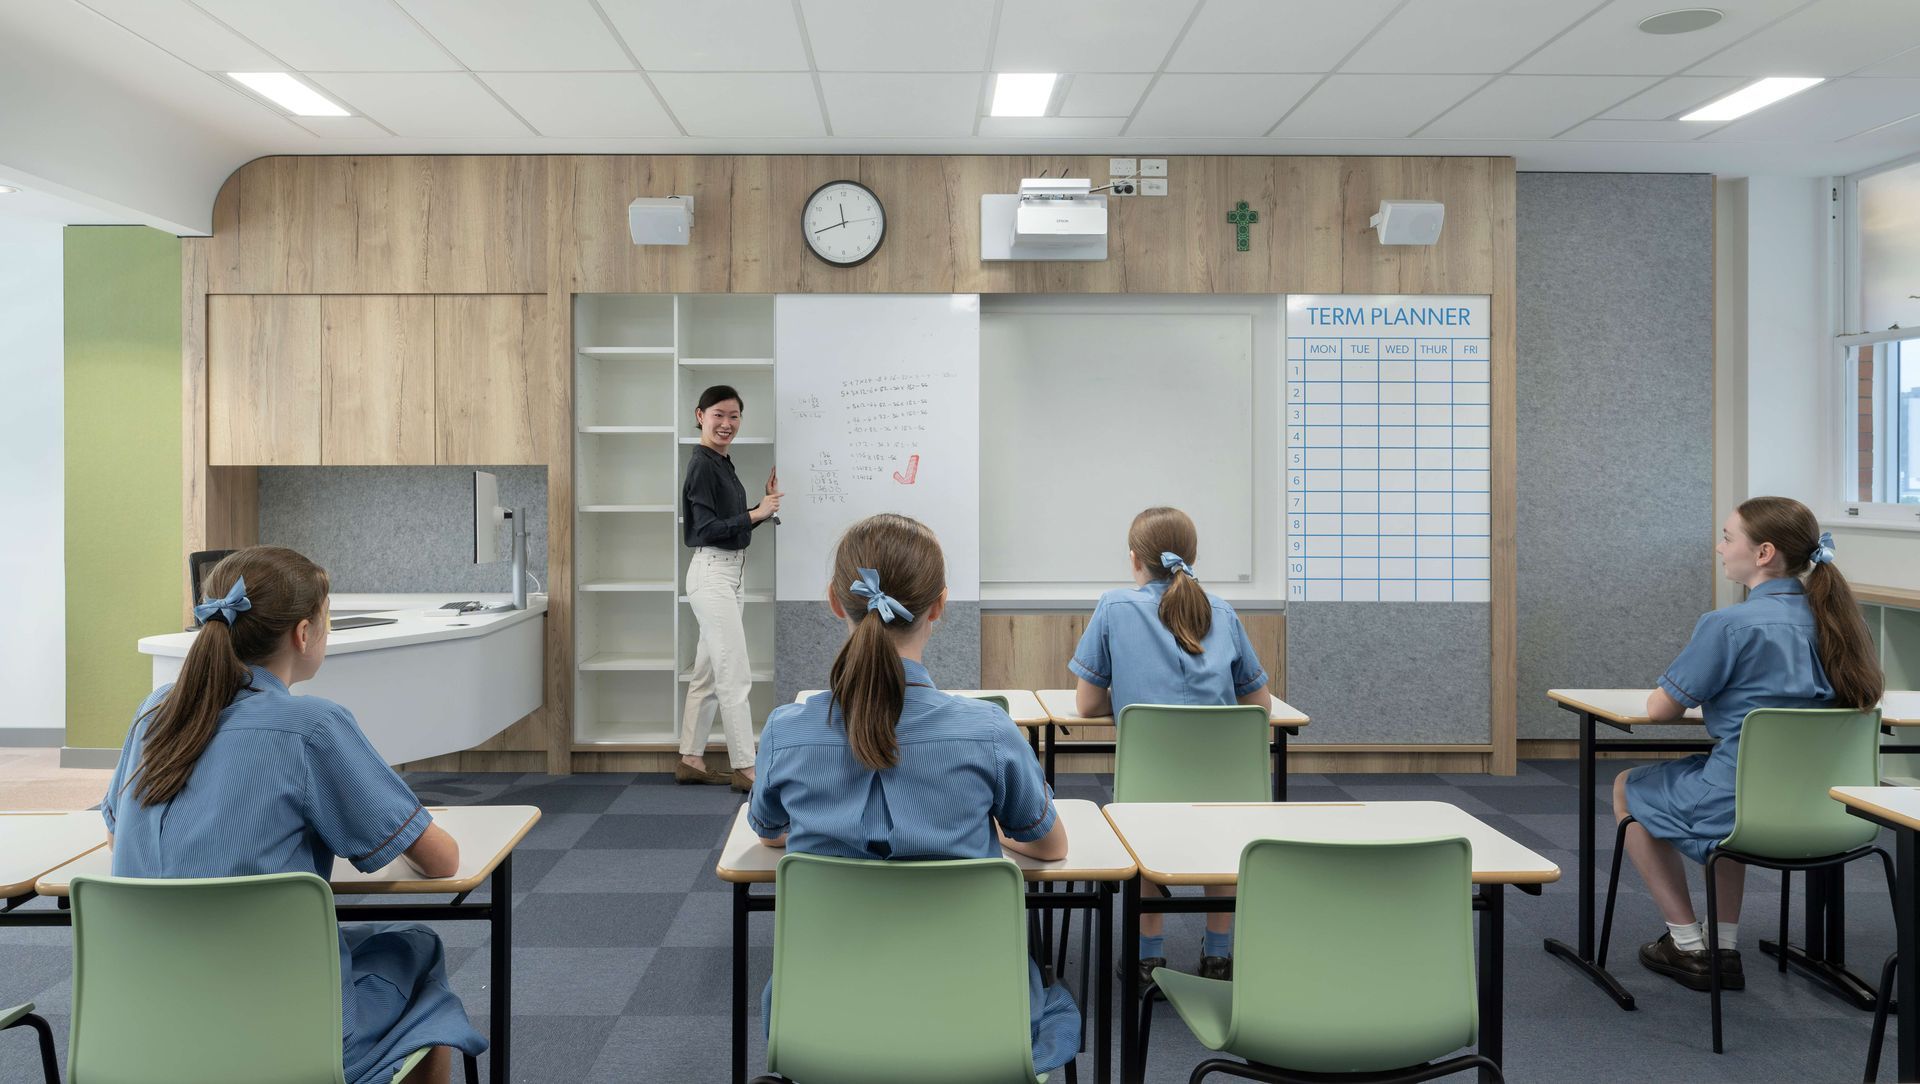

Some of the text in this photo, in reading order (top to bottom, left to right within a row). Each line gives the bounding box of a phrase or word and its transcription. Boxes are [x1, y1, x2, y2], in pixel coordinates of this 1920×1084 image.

[1307, 307, 1470, 325] TERM PLANNER
[1310, 345, 1477, 354] MON TUE WED THUR FRI
[1294, 367, 1299, 375] 1
[1294, 389, 1299, 397] 2
[1294, 410, 1299, 419] 3
[1293, 432, 1300, 440] 4
[1294, 454, 1299, 463] 5
[1293, 476, 1300, 485] 6
[1294, 498, 1299, 506] 7
[1294, 520, 1300, 528] 8
[1294, 542, 1300, 551] 9
[1292, 564, 1302, 572] 10
[1293, 586, 1301, 594] 11
